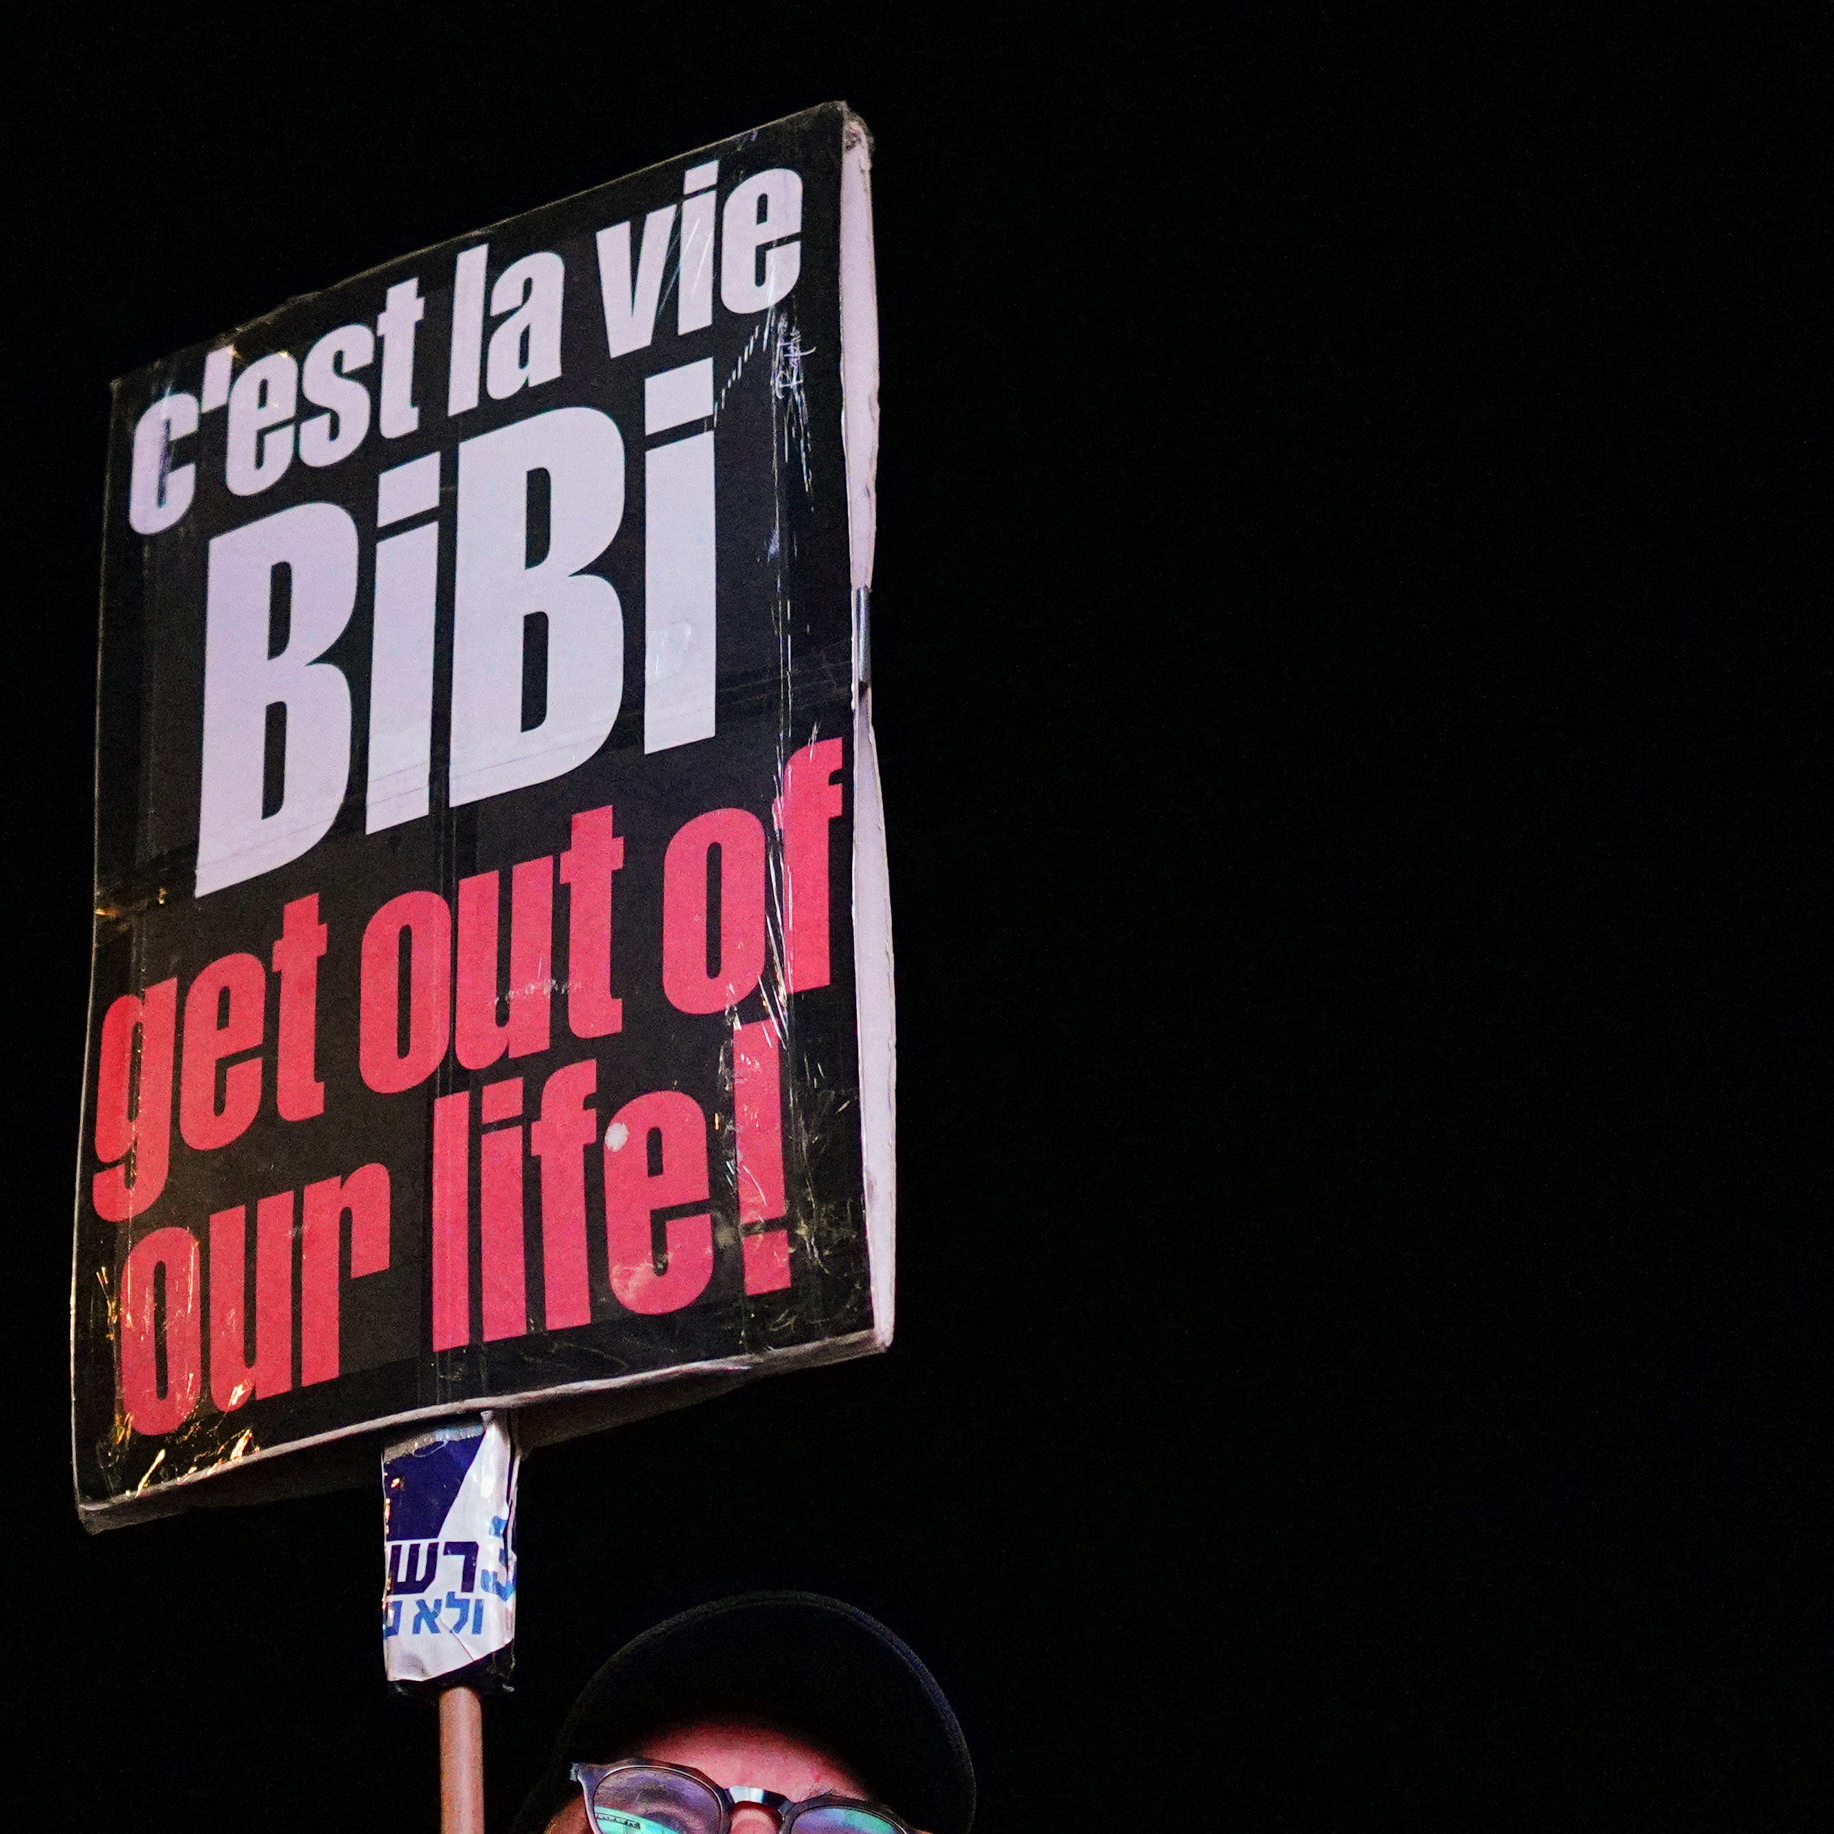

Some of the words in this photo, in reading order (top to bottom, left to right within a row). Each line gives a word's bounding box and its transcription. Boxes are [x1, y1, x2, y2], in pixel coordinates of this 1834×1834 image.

[129, 278, 425, 535] c'est
[448, 243, 565, 417] la
[596, 159, 803, 359] vie
[194, 358, 717, 899] BiBi
[92, 892, 328, 1223] get
[358, 804, 625, 1094] out
[662, 737, 843, 1015] of
[118, 1162, 391, 1436] our
[431, 1016, 792, 1353] life!
